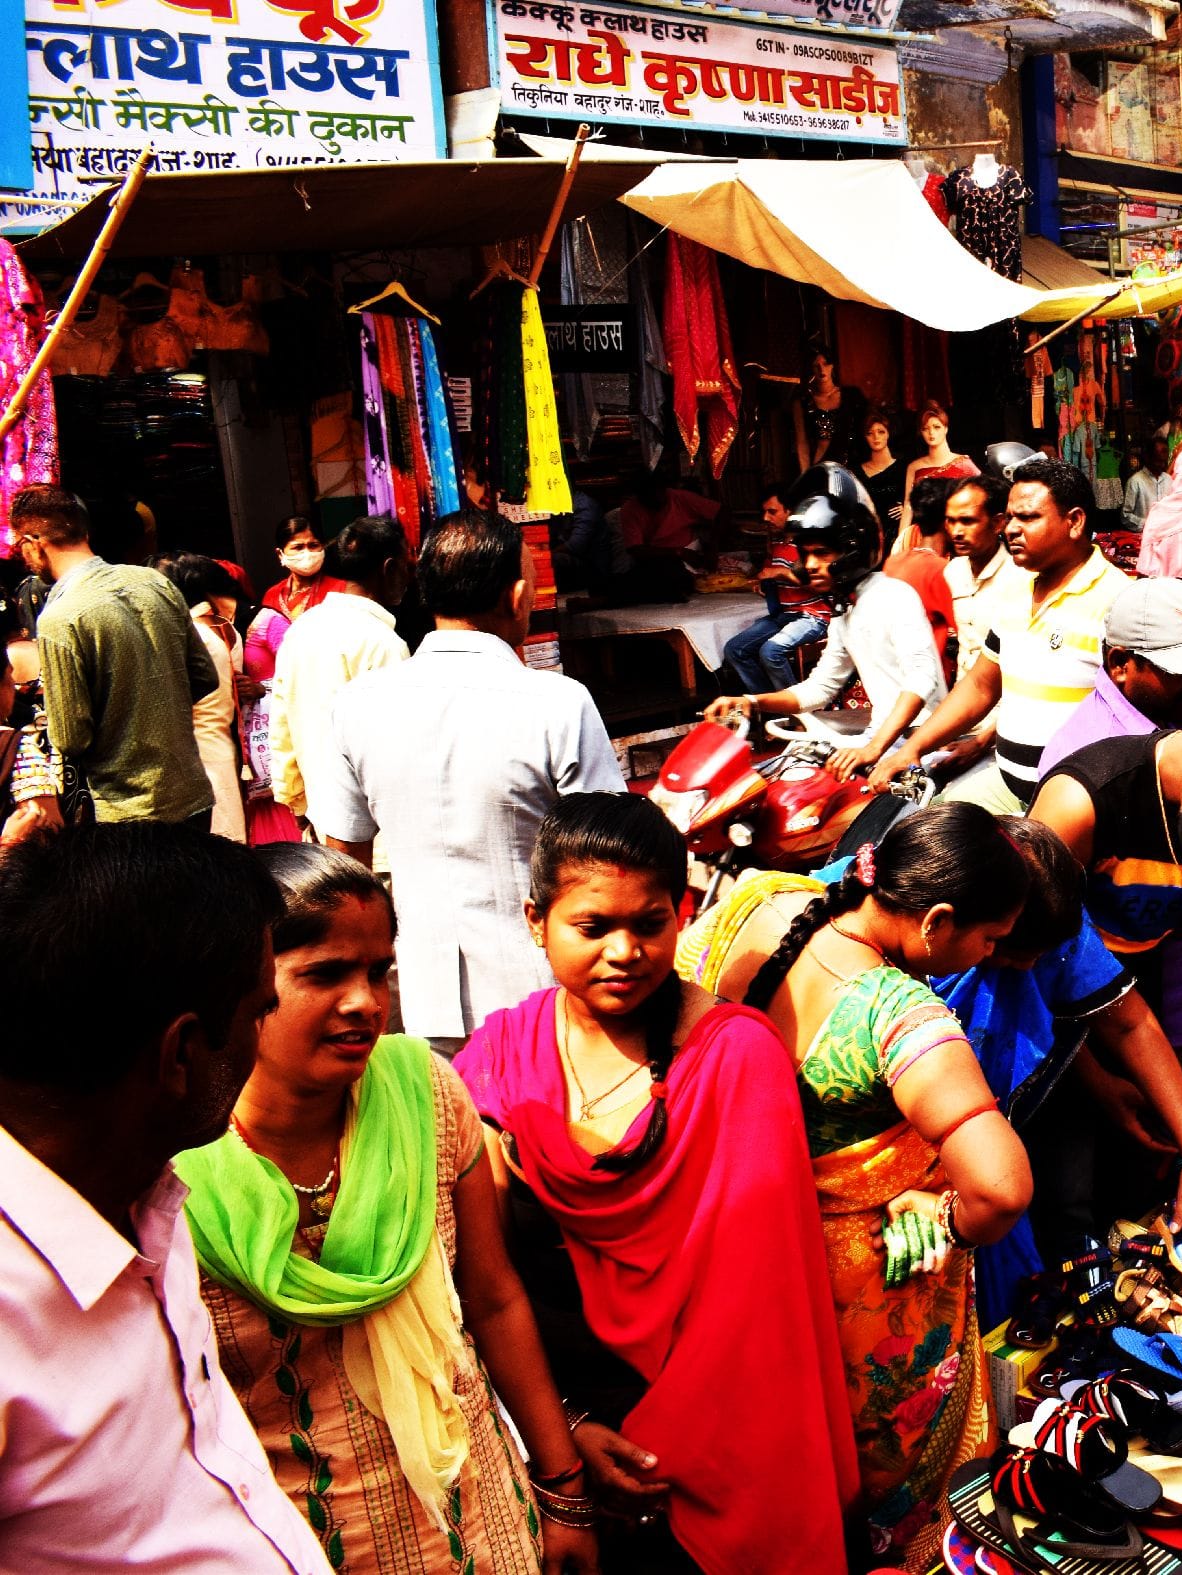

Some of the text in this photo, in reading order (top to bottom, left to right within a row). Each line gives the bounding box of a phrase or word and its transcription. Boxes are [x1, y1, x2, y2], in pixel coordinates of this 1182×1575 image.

[651, 18, 708, 42] हाउस
[226, 36, 410, 100] हाउस
[504, 29, 631, 86] राधे
[641, 50, 785, 116] कृष्णा
[116, 88, 240, 137] मैक्सी
[248, 99, 300, 139] की
[307, 111, 415, 155] दुकान
[544, 321, 623, 353] लाथ हाउस
